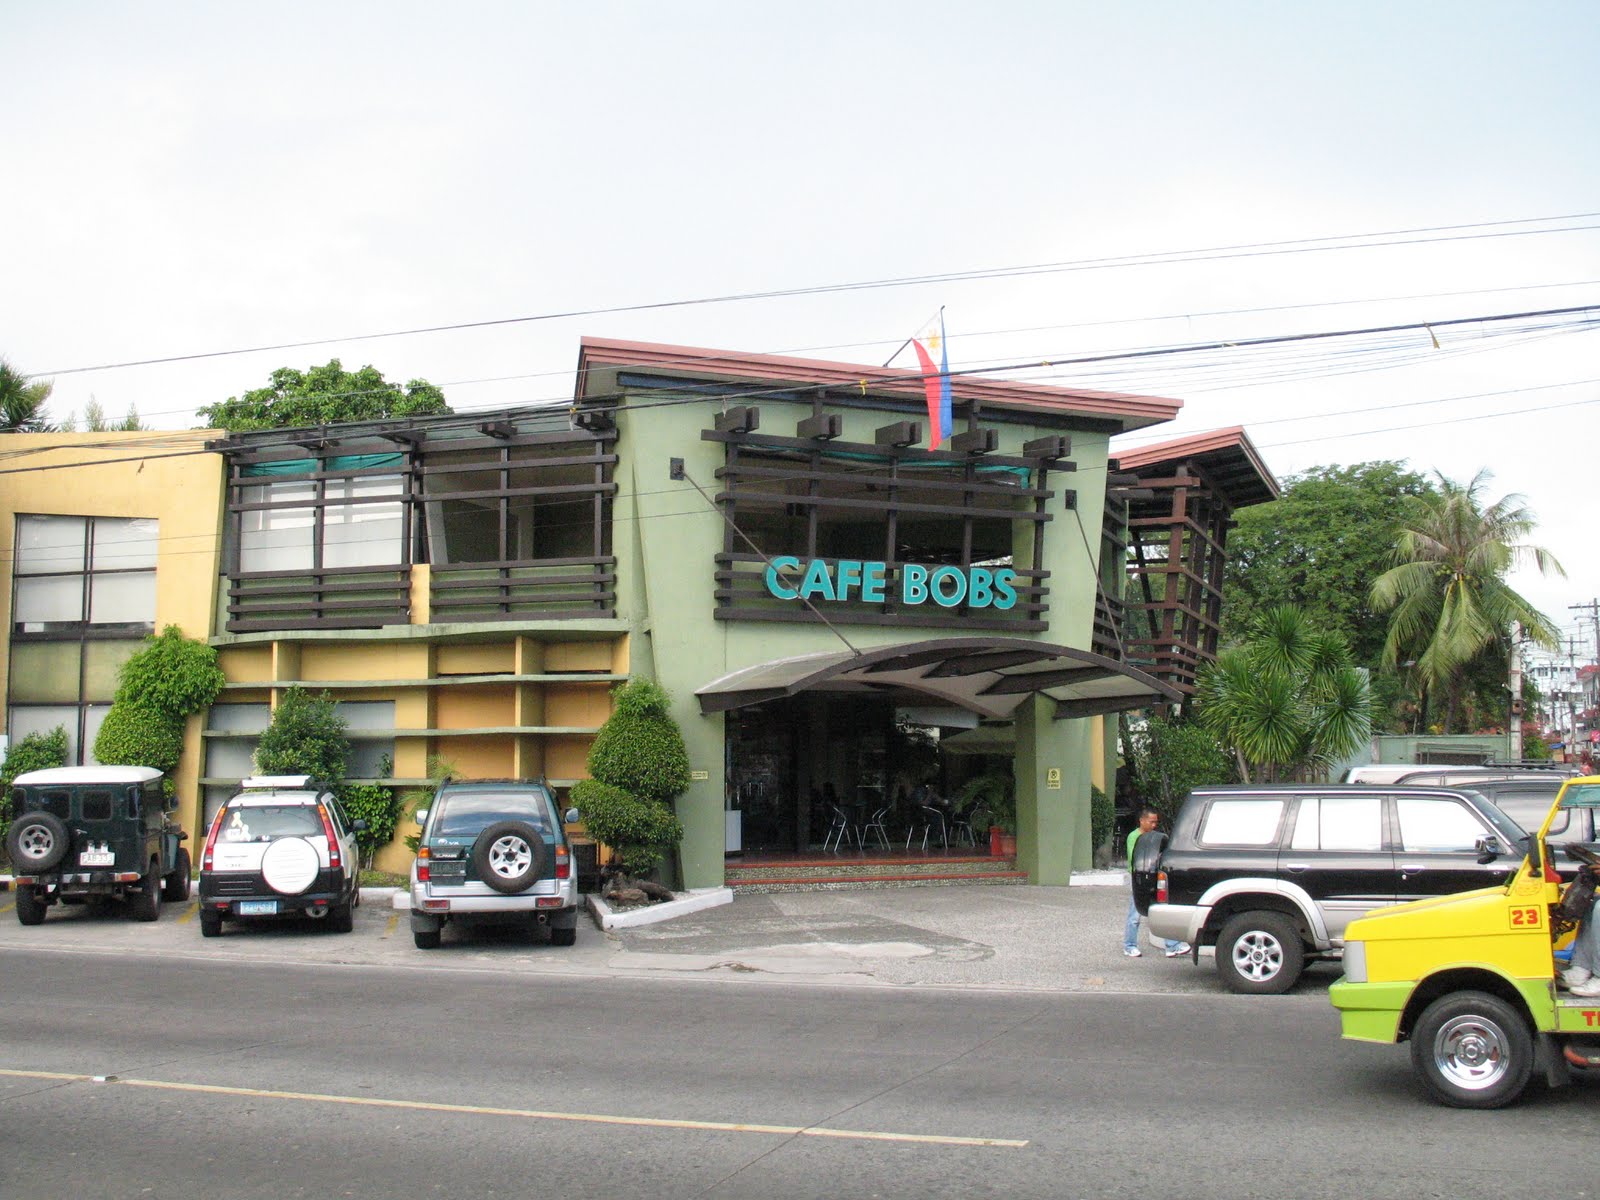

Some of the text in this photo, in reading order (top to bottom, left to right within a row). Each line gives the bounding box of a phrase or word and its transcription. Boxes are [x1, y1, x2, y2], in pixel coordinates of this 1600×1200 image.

[764, 555, 1018, 610] CAFE BOBS
[1512, 909, 1538, 925] 23
